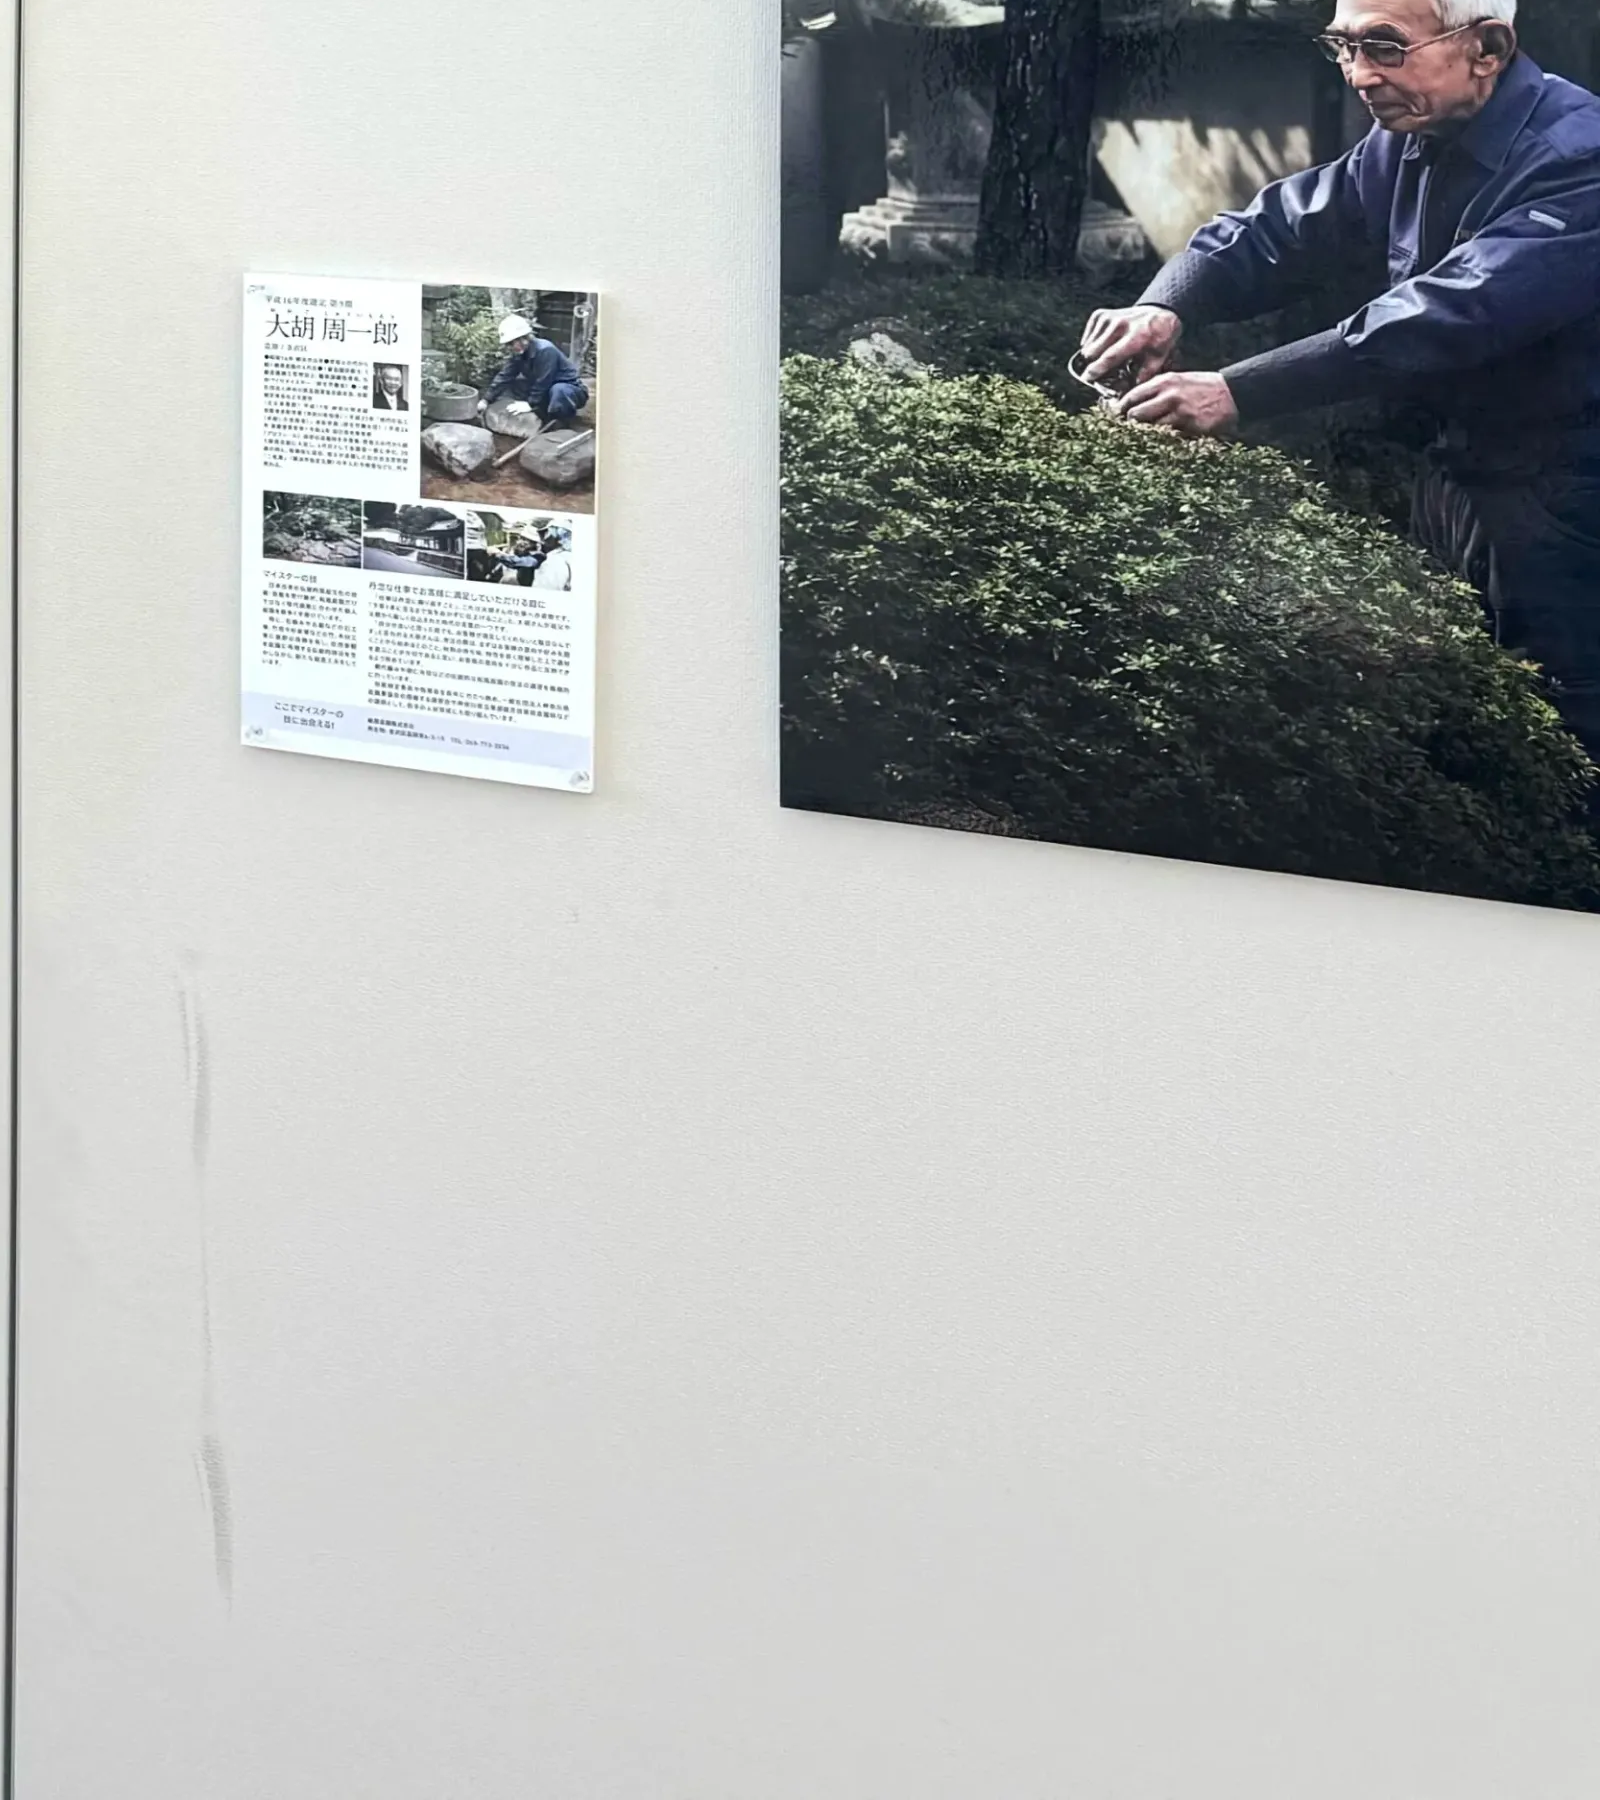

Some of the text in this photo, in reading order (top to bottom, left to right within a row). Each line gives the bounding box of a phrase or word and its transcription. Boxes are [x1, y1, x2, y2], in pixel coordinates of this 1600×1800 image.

[265, 312, 398, 345] 大胡 周一郎
